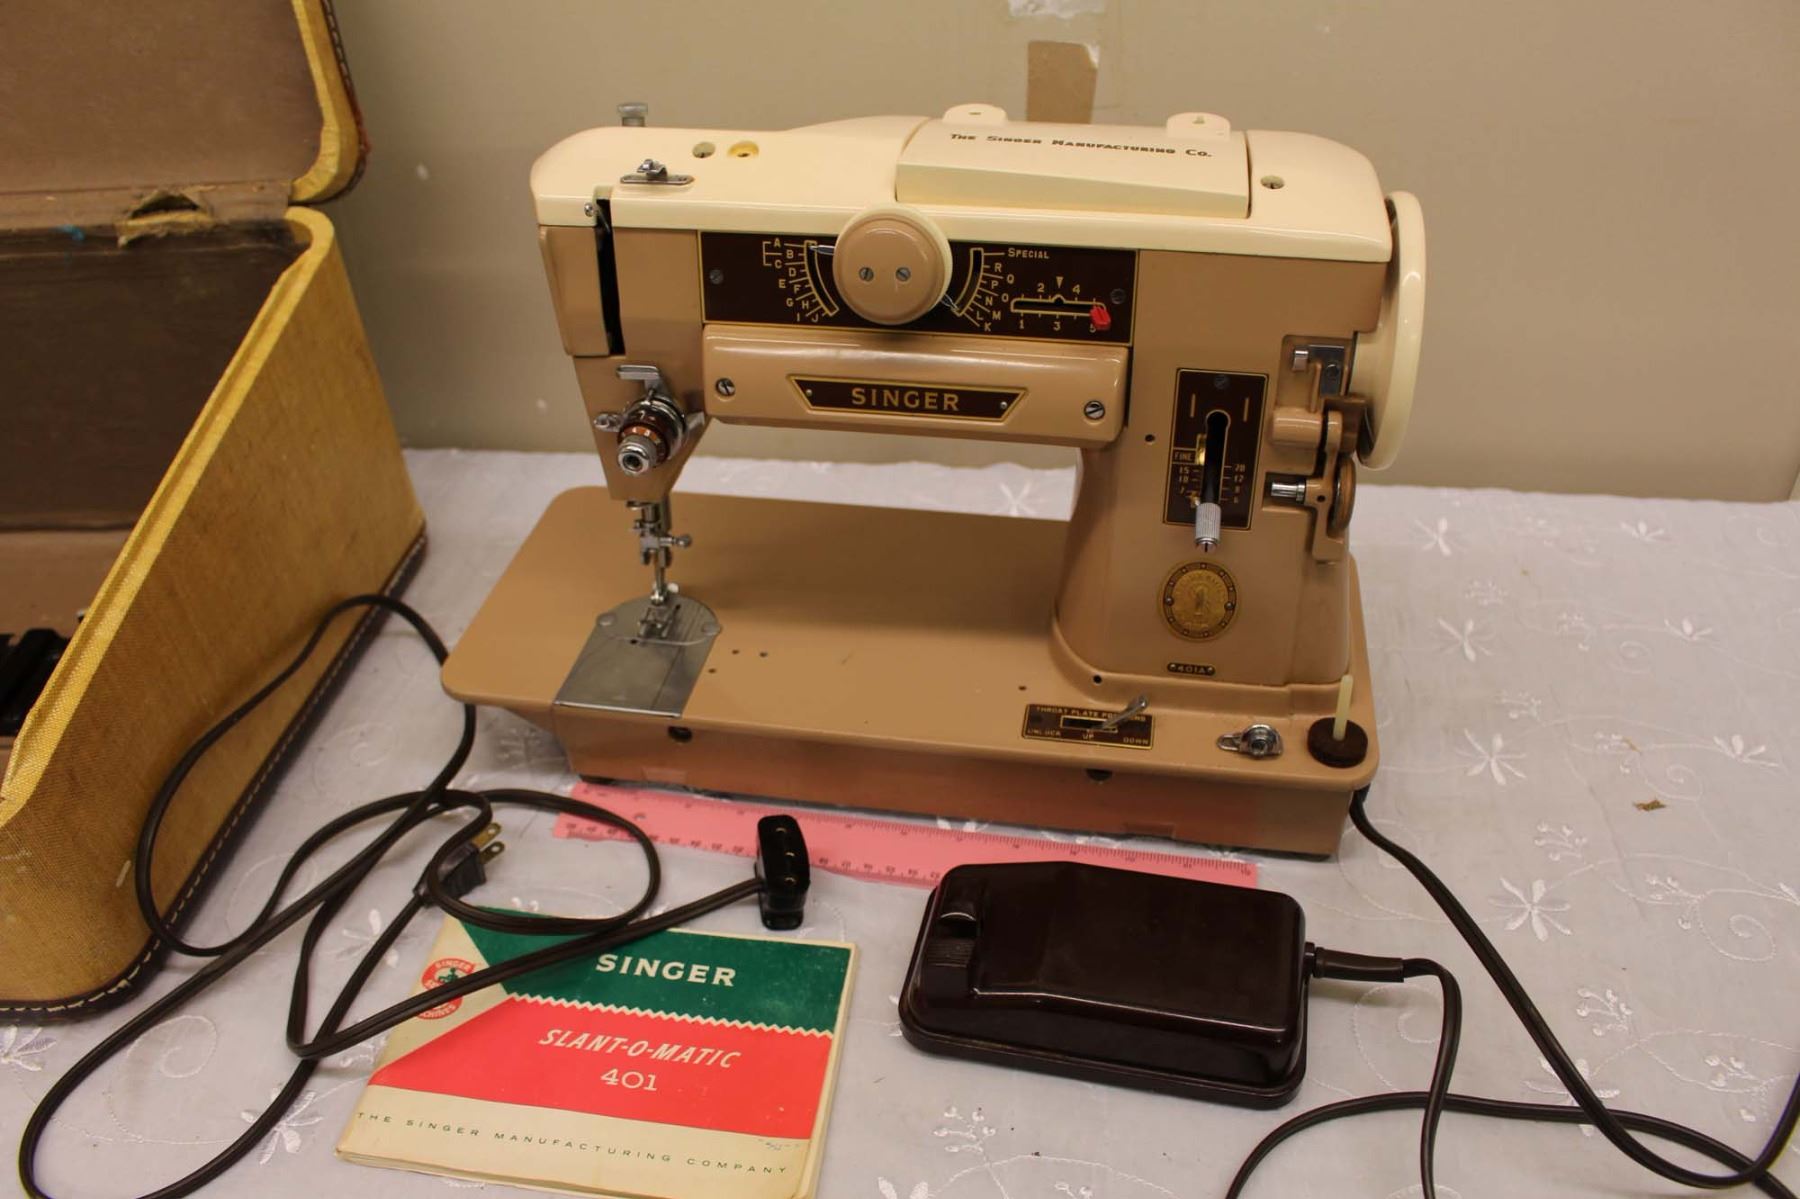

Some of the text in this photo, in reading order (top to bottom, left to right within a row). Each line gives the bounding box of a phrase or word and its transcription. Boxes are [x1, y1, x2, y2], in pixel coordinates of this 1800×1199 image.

[1051, 139, 1176, 154] MANUFACTURING
[774, 238, 781, 248] A
[786, 250, 794, 259] B
[1008, 247, 1050, 259] SPECIAL
[774, 259, 782, 269] C
[994, 263, 1002, 272] R
[789, 267, 796, 277] D
[779, 279, 786, 289] E
[793, 284, 800, 293] F
[991, 281, 999, 290] P
[1037, 282, 1045, 292] 2
[1072, 284, 1081, 295] 4
[801, 300, 809, 309] H
[985, 296, 993, 306] N
[811, 313, 819, 322] J
[976, 311, 984, 321] L
[992, 311, 1001, 321] M
[984, 322, 992, 332] K
[1019, 320, 1025, 330] 1
[1053, 321, 1061, 331] 3
[851, 387, 960, 412] SINGER
[1071, 709, 1099, 717] PLATE
[1123, 737, 1149, 745] DOWN
[595, 953, 736, 987] SINGER
[538, 1029, 741, 1068] SLANT-O-MATIC
[600, 1068, 657, 1091] 401
[356, 1112, 787, 1174] THE SINGER MANUFACTURING COMPANY
